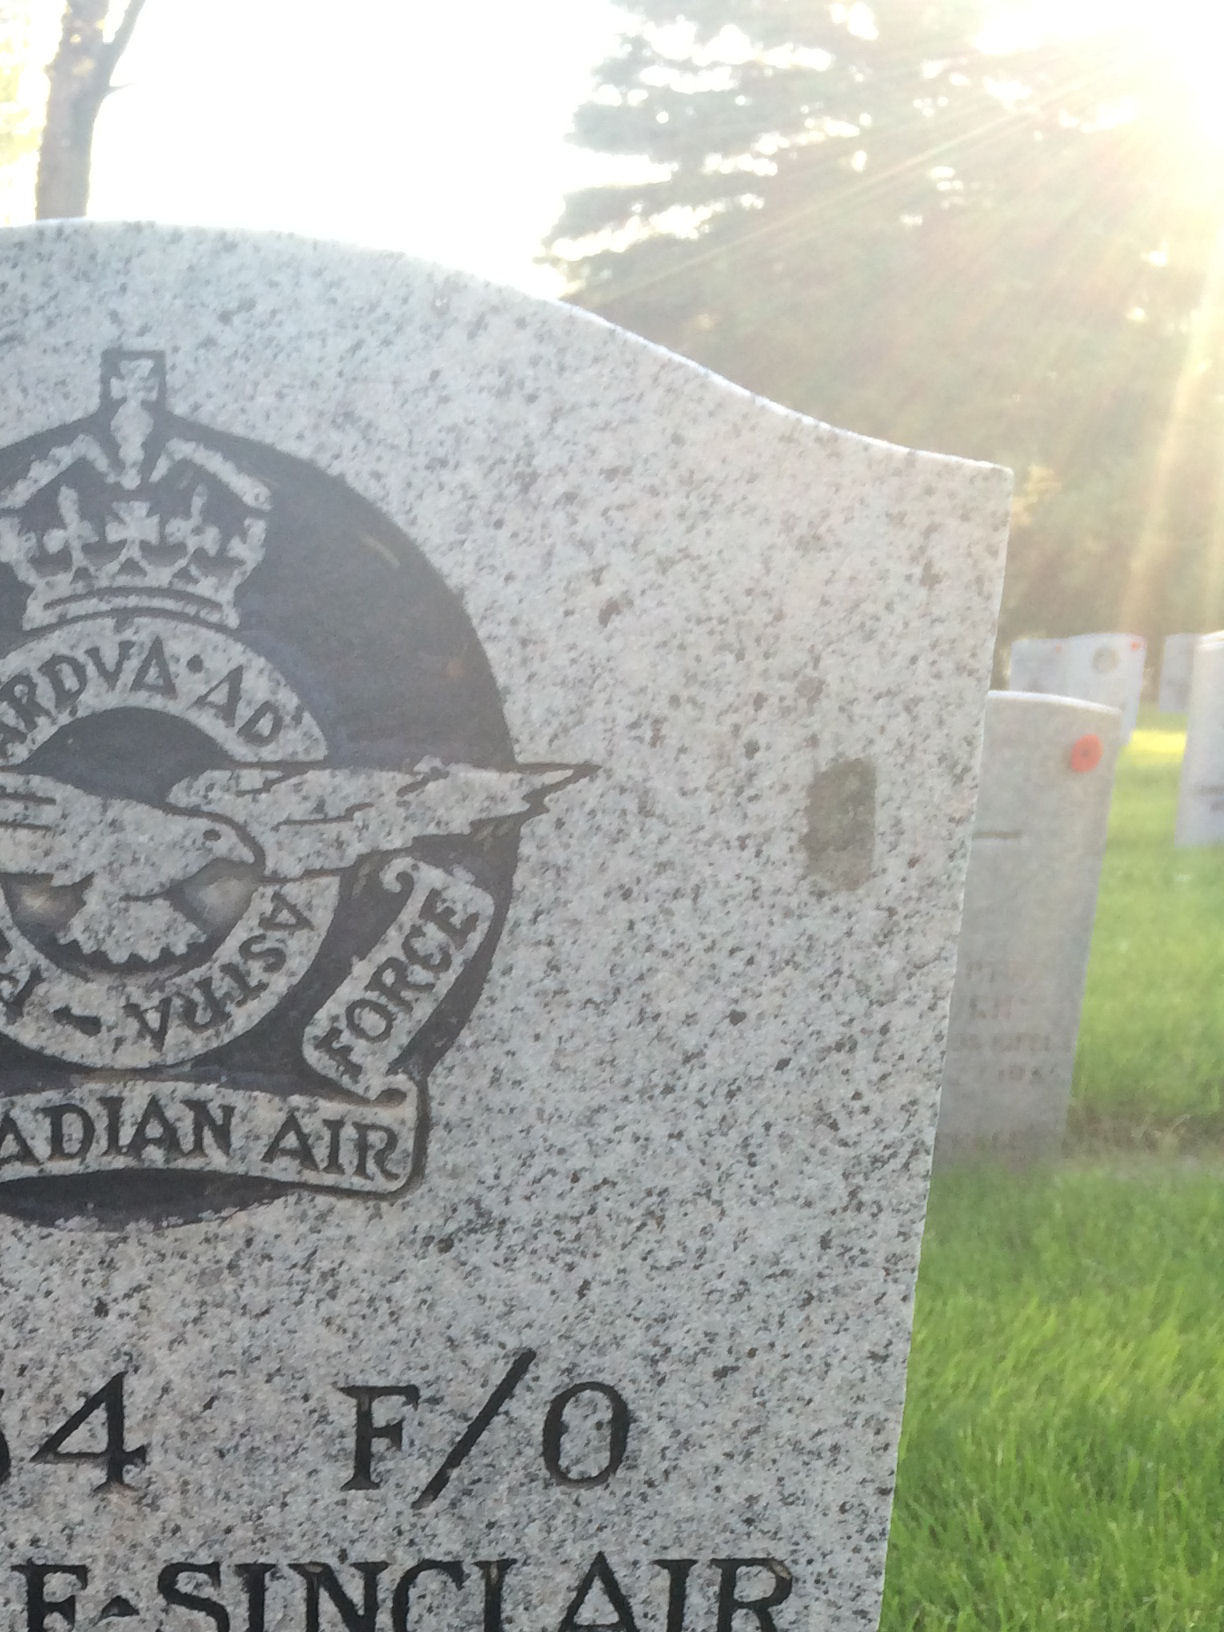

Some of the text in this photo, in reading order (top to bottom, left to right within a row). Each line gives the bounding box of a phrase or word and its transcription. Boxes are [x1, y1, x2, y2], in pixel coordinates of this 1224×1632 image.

[314, 888, 479, 1082] FORCE
[260, 1110, 400, 1182] AIR
[341, 1348, 634, 1508] F/O
